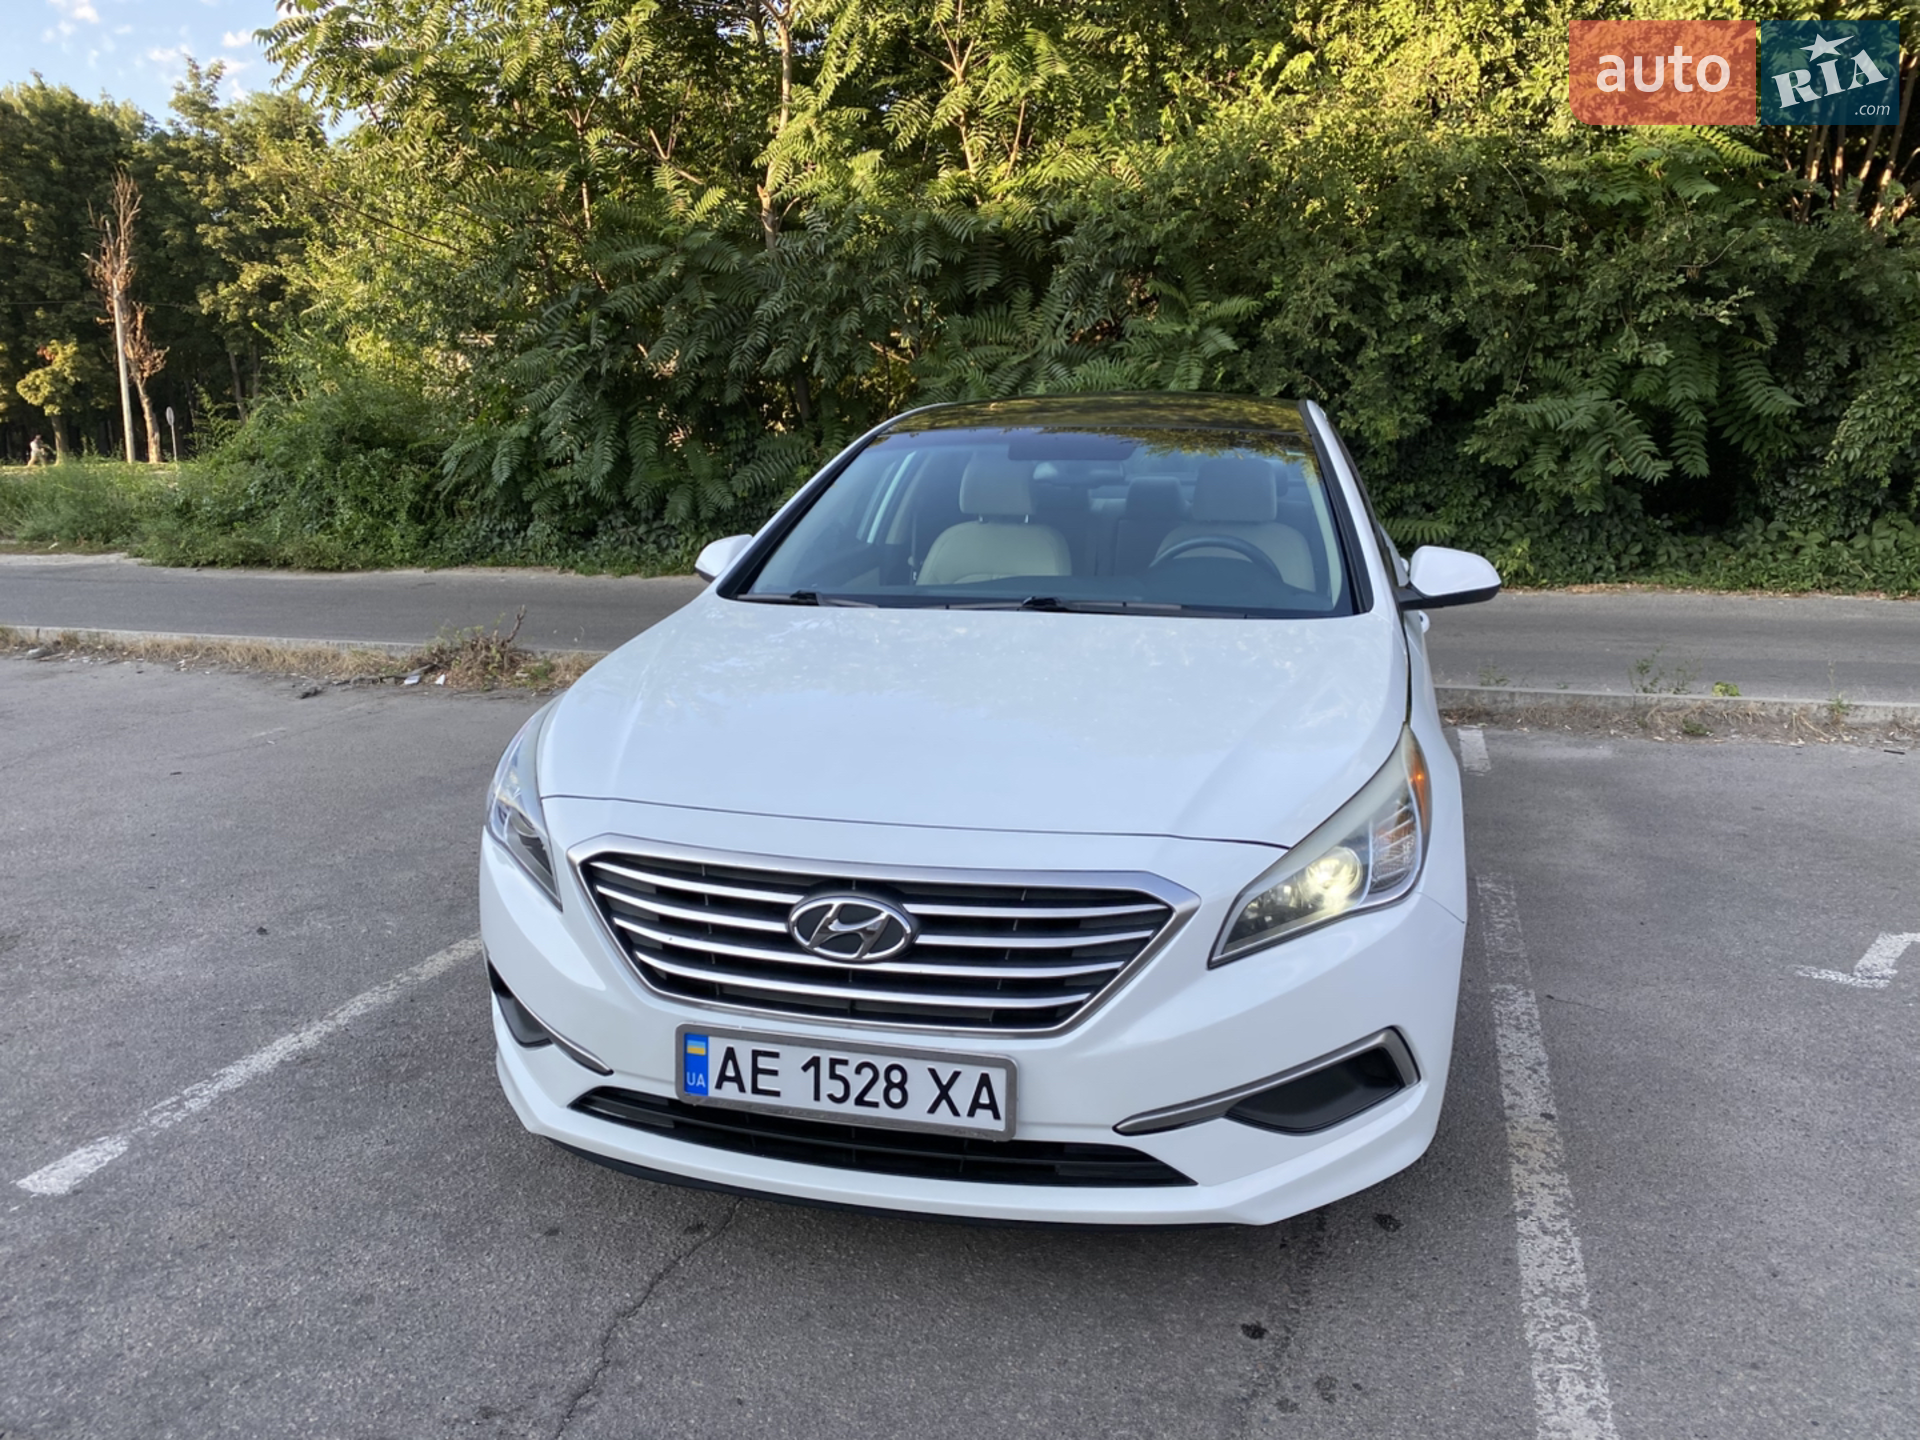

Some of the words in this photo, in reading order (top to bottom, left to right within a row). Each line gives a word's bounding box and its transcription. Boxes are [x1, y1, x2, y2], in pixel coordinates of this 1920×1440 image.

[686, 1072, 706, 1087] UA
[714, 1046, 781, 1097] AE
[801, 1056, 908, 1109] 1528
[926, 1067, 1001, 1120] XA
